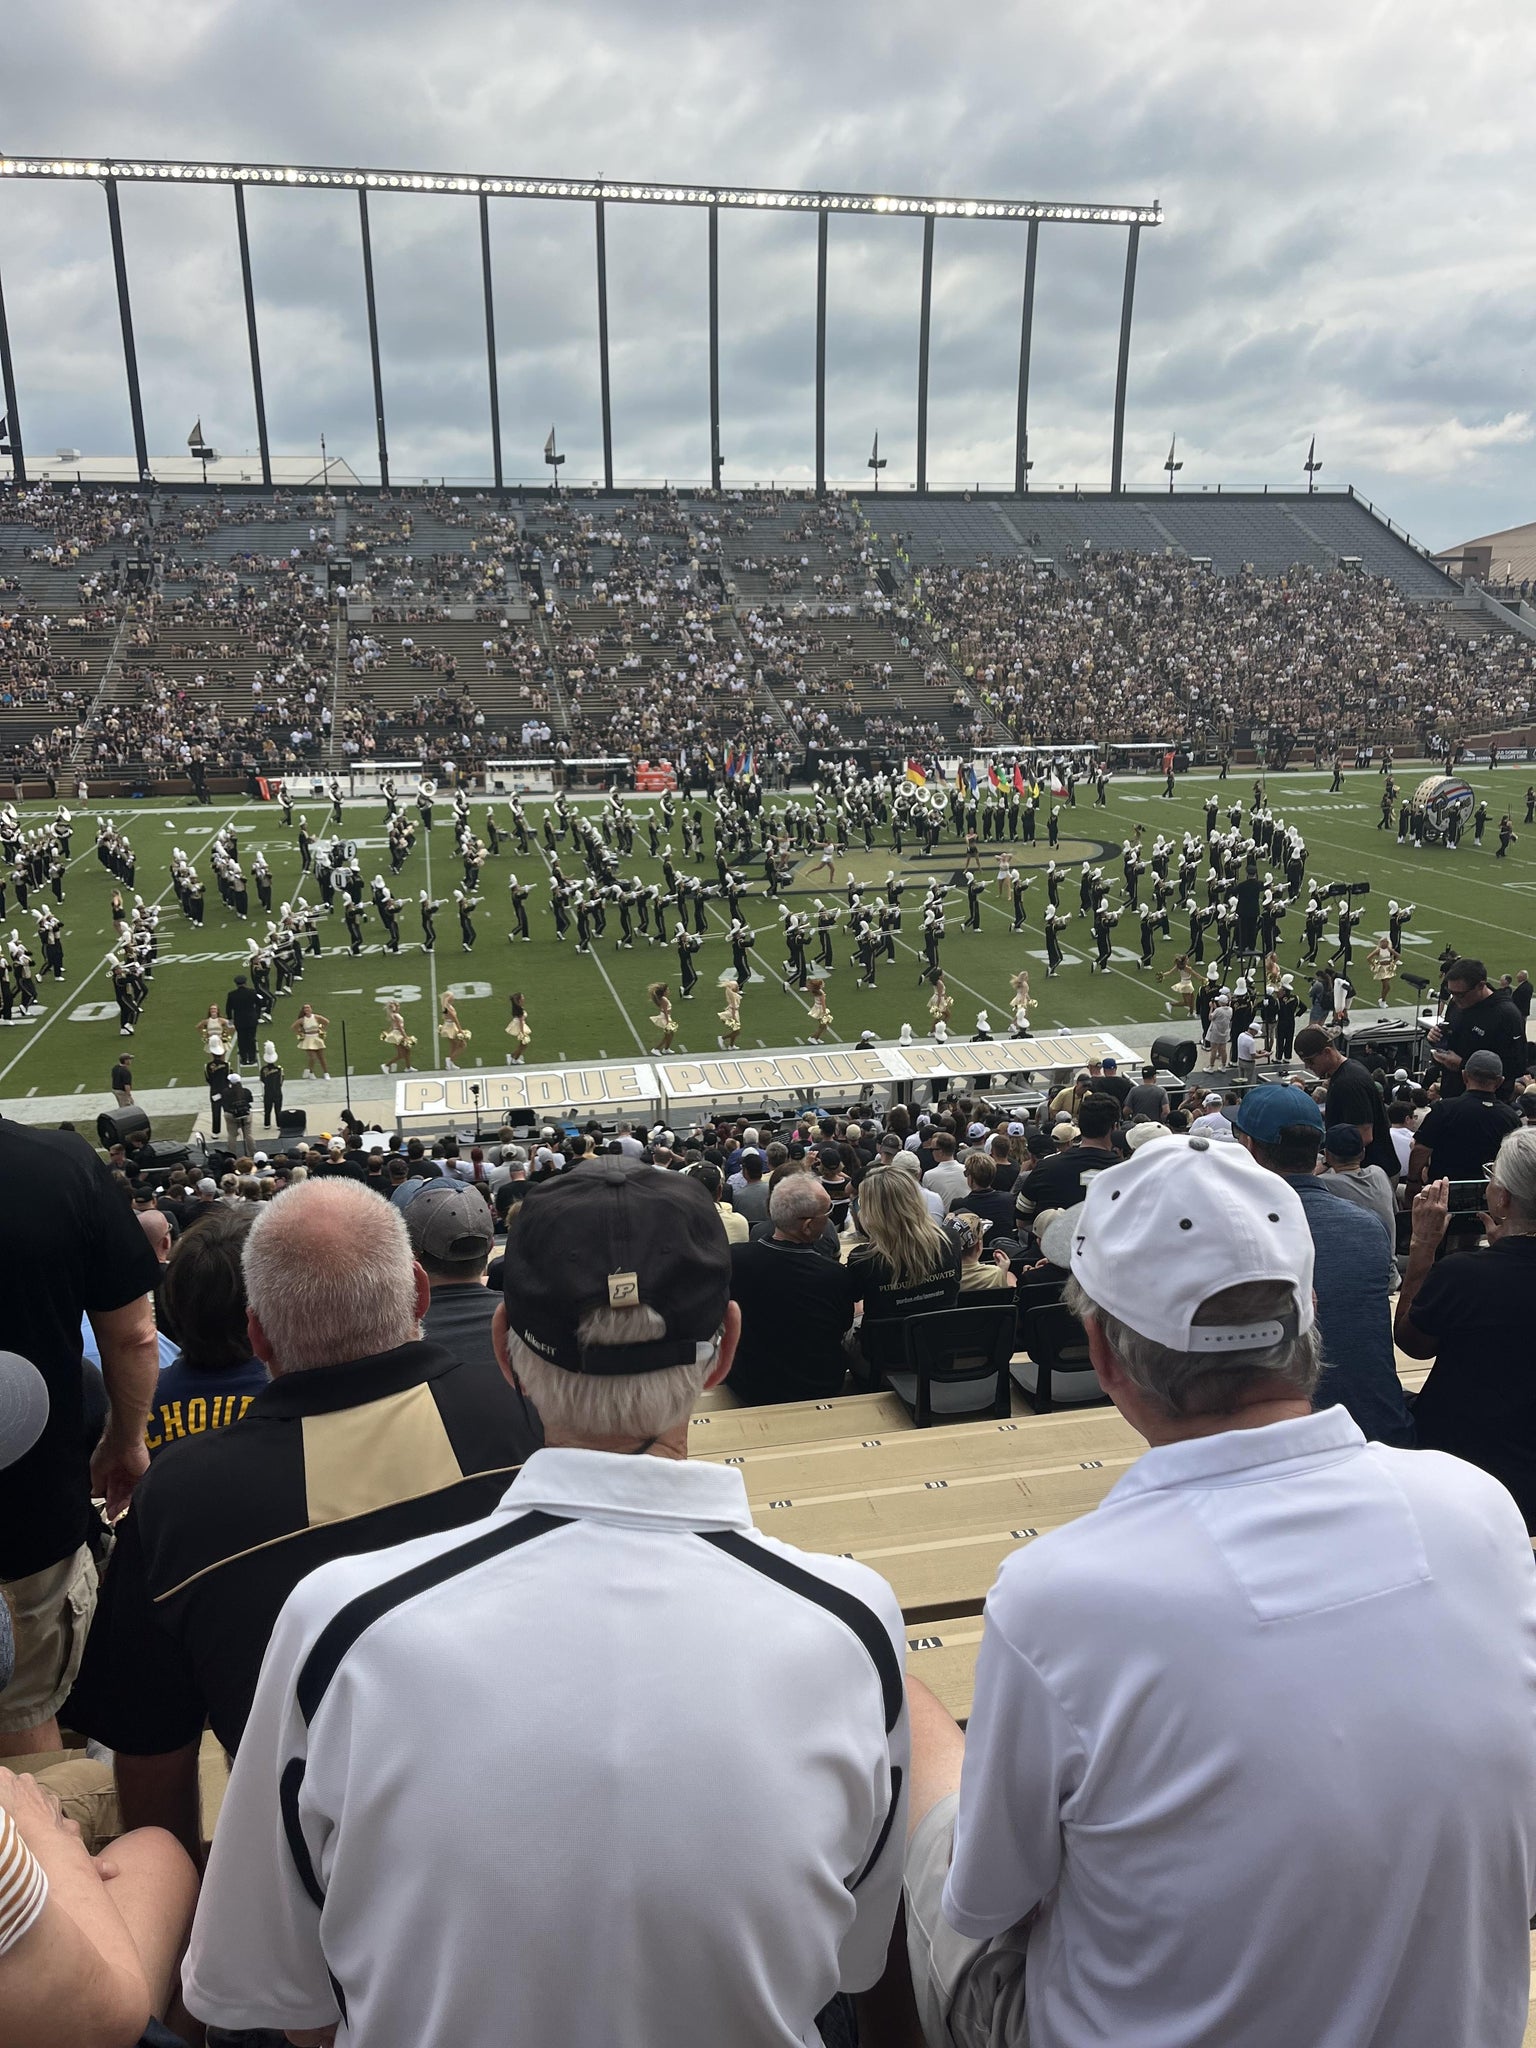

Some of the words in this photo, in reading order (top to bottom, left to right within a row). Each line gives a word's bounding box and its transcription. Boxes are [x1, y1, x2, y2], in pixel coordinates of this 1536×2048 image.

[374, 984, 493, 1003] 30
[404, 1066, 641, 1111] PURDUE
[663, 1051, 894, 1094] PURDUE
[902, 1035, 1122, 1074] PURDUE
[613, 1282, 635, 1299] P
[773, 1500, 788, 1509] 17
[1015, 1529, 1034, 1538] 16
[917, 1638, 937, 1650] 17
